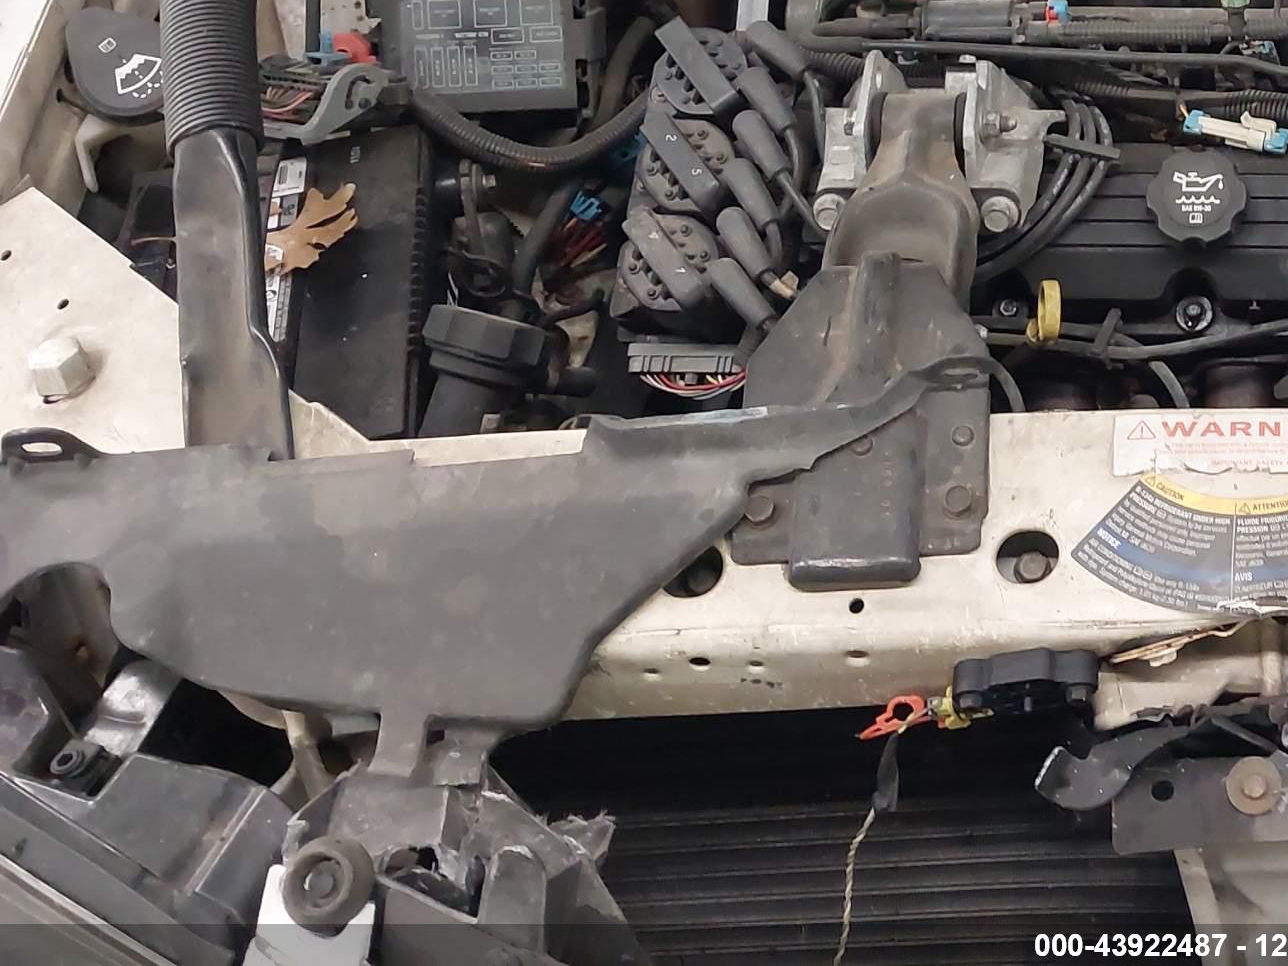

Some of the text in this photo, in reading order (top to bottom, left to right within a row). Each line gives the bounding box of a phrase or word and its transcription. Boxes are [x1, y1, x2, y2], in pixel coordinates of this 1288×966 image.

[1156, 481, 1185, 501] CAUTION
[1236, 523, 1268, 535] PRESSION
[1095, 527, 1123, 550] NOTICE
[1234, 569, 1253, 582] AVIS
